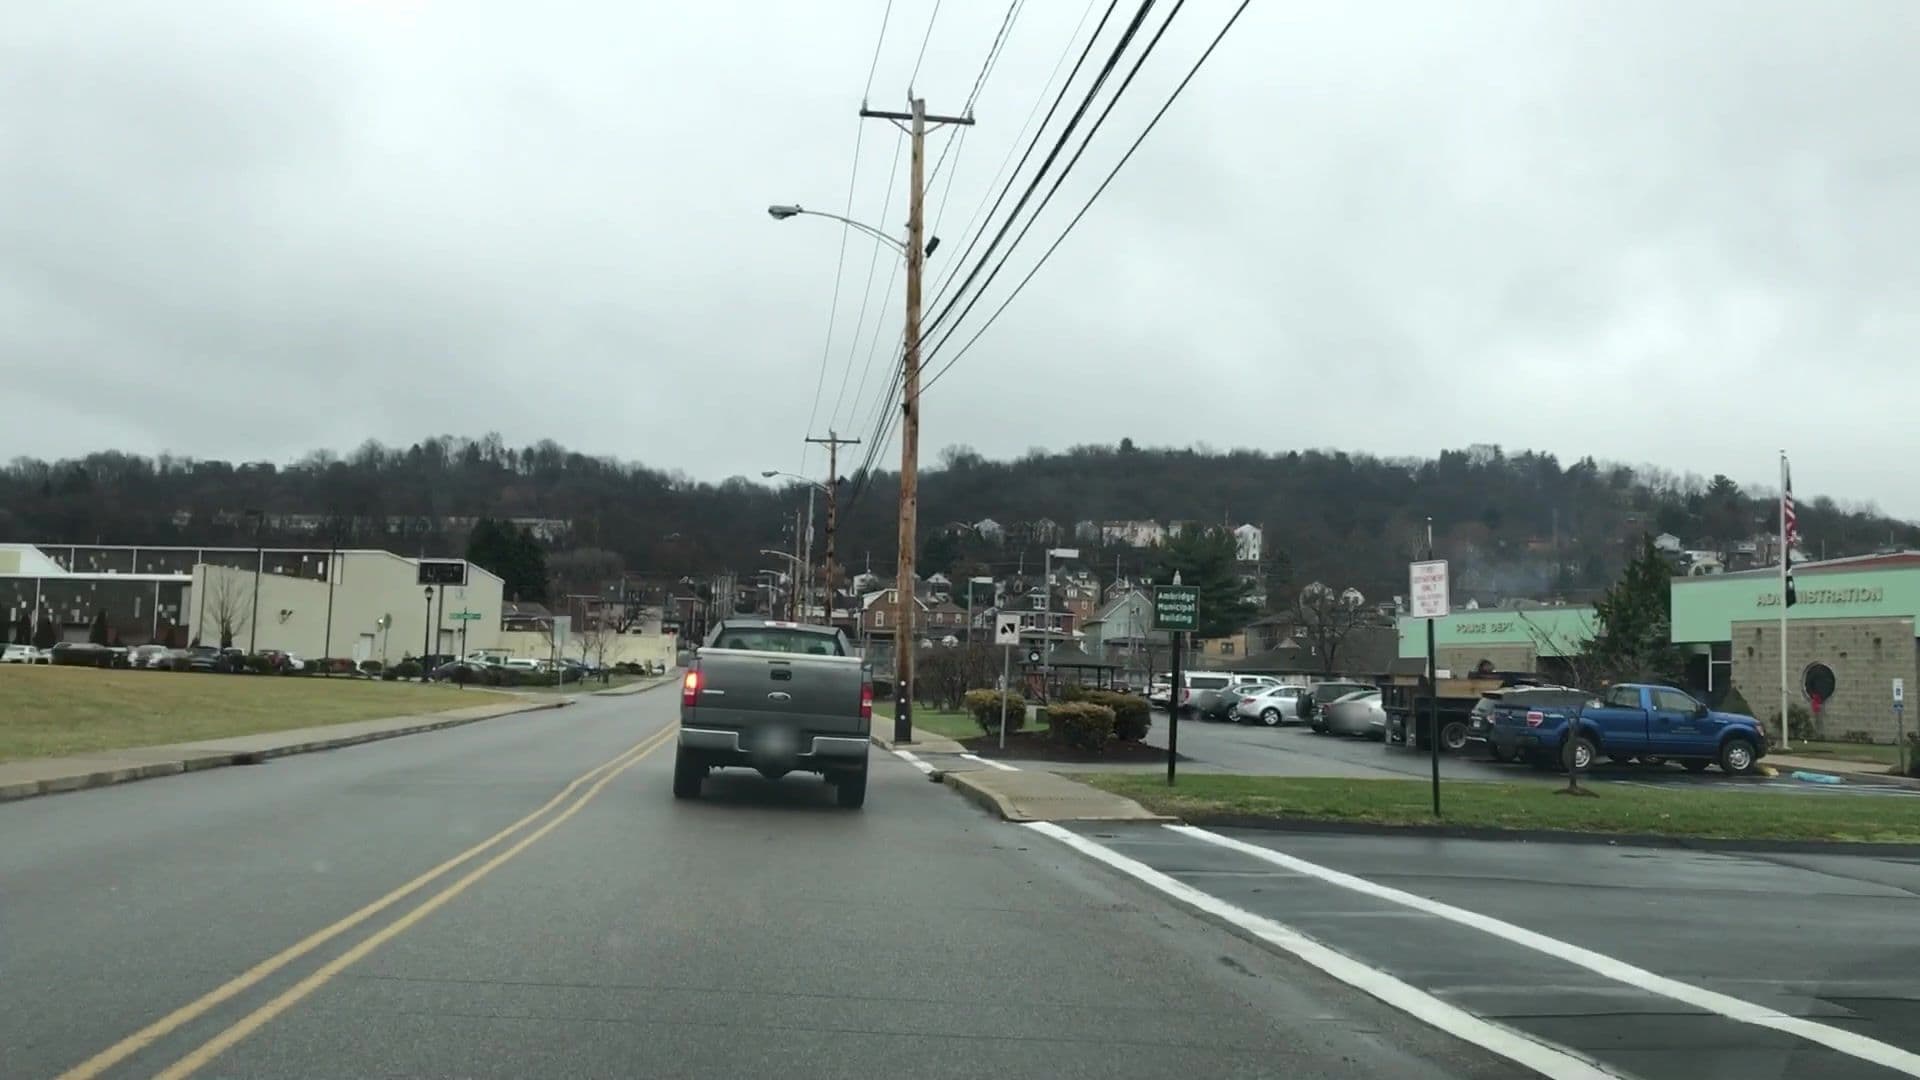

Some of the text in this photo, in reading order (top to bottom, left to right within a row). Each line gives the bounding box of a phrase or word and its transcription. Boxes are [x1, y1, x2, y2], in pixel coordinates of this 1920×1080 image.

[1158, 592, 1195, 602] Ambridge
[1757, 587, 1883, 606] ADNISTRATION
[1158, 603, 1195, 612] Municipal
[1160, 613, 1192, 624] Building
[1456, 623, 1487, 633] POLICE
